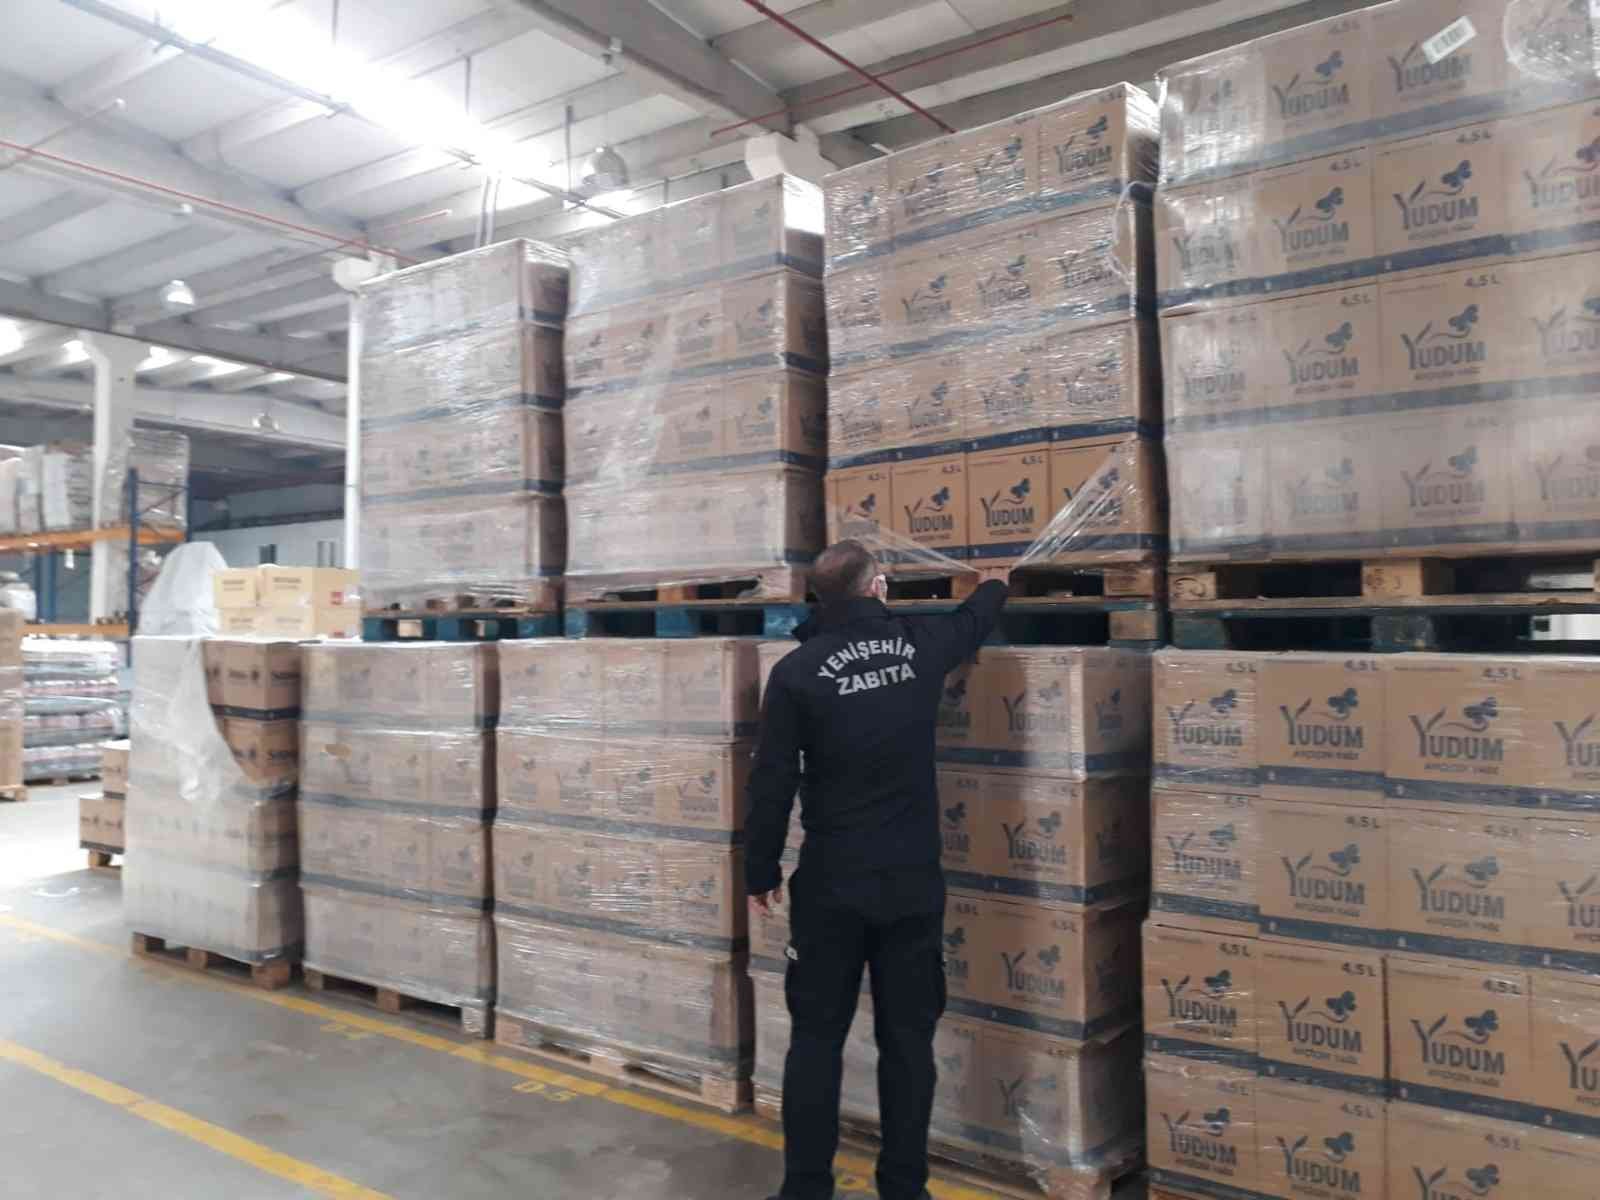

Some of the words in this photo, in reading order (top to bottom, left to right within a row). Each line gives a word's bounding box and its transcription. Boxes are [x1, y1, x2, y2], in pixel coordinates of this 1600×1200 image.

[1272, 74, 1351, 118] YUDUM
[1272, 205, 1350, 252] YUDUM
[1393, 181, 1479, 230] YUDUM
[1282, 340, 1359, 384] YUDUM
[1401, 322, 1487, 370] YUDUM
[1403, 463, 1484, 506] YUDUM
[904, 498, 953, 534] YUDUM
[980, 490, 1034, 528] YUDUM
[817, 637, 916, 679] YENİŞEHİR
[835, 662, 916, 695] ZABITA
[1166, 699, 1243, 746] YUDUM
[1279, 698, 1364, 749] YUDUM
[1409, 707, 1504, 761] YUDUM
[1167, 832, 1242, 880] YUDUM
[1281, 853, 1365, 905] YUDUM
[1411, 865, 1505, 920] YUDUM
[1160, 974, 1238, 1028] YUDUM
[1278, 997, 1363, 1053] YUDUM
[1410, 1015, 1506, 1075] YUDUM
[1159, 1110, 1238, 1167] YUDUM
[1275, 1135, 1361, 1192] YUDUM
